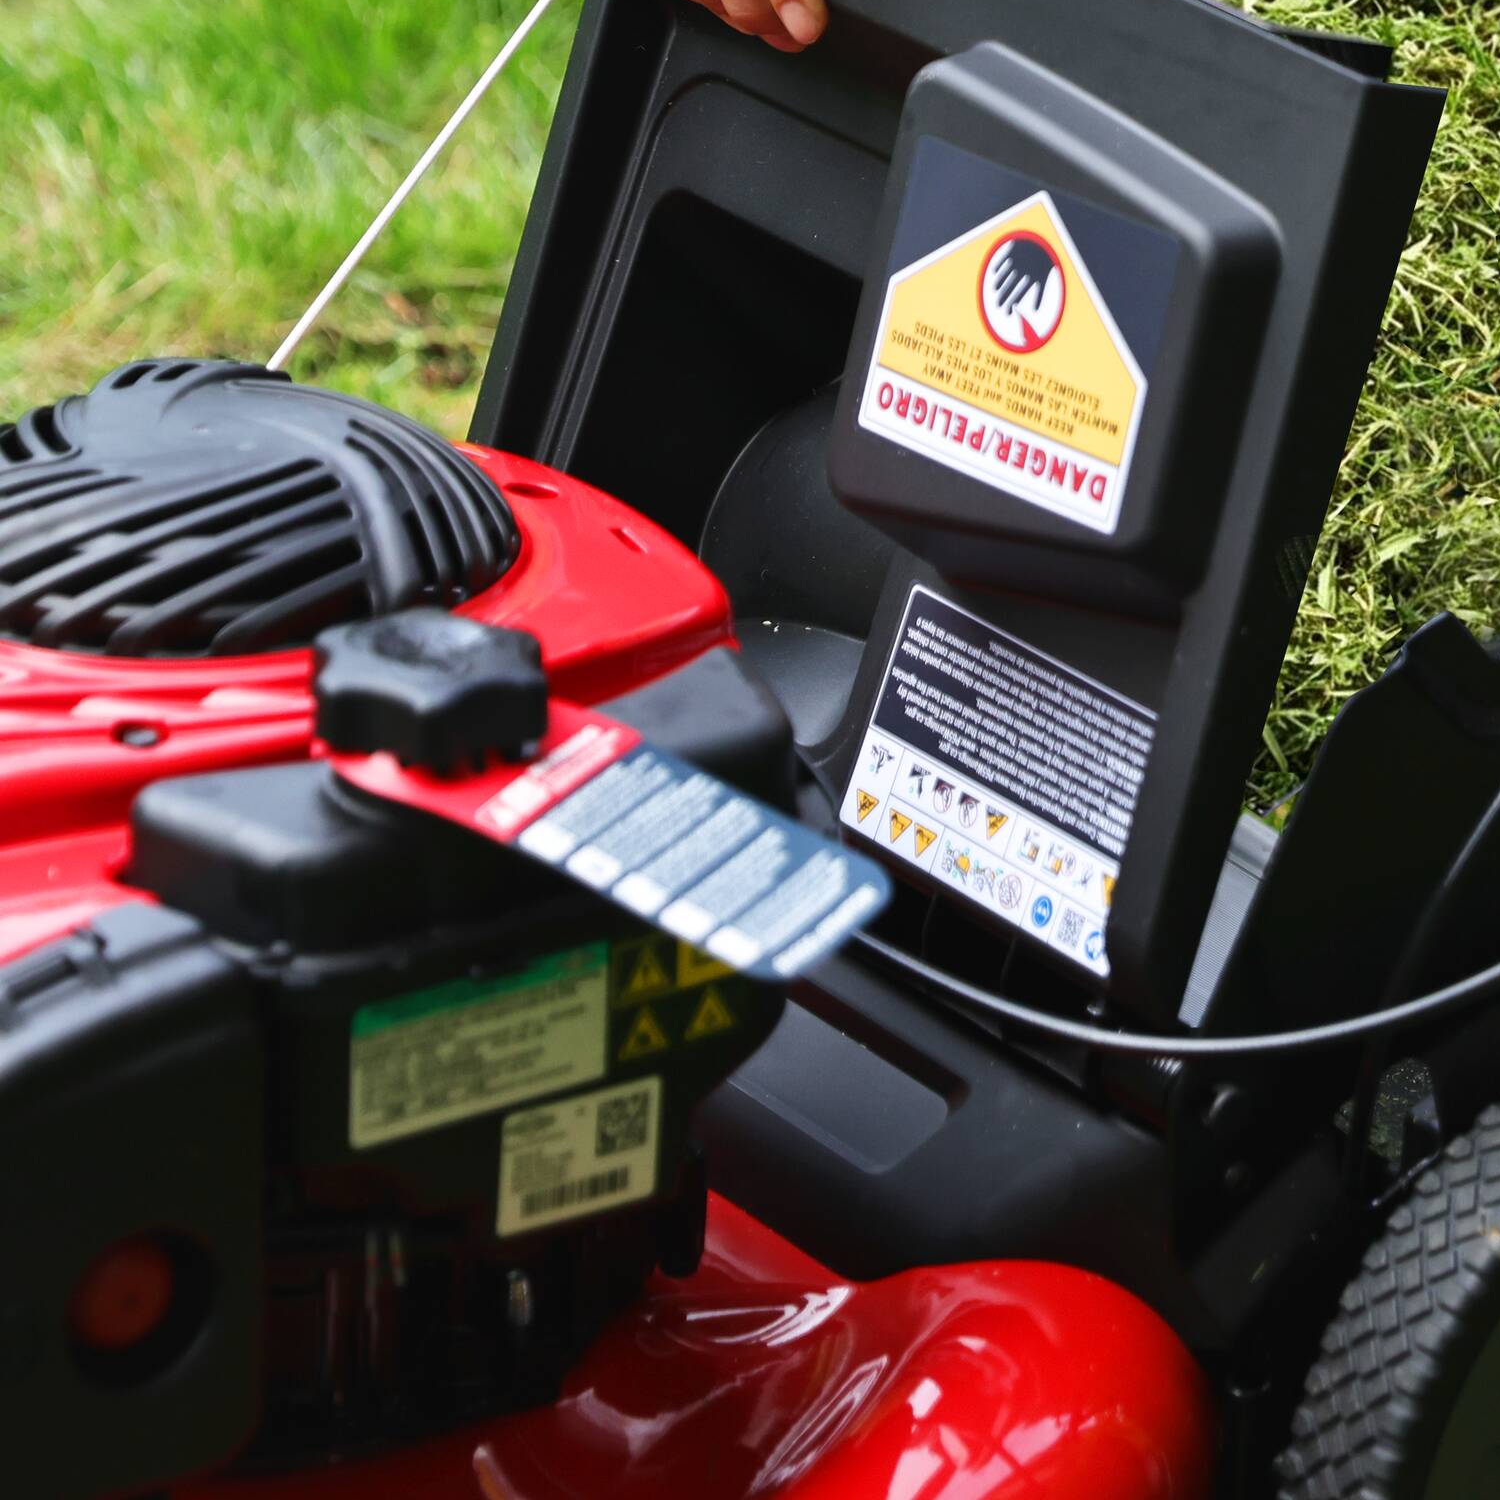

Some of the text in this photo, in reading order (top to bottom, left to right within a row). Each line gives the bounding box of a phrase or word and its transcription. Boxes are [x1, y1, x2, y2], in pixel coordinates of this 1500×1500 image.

[914, 322, 944, 343] PIEDS
[891, 330, 942, 360] ALEJADOS
[948, 336, 966, 353] LES
[970, 347, 981, 358] ET
[946, 354, 969, 372] PIES
[985, 353, 1019, 375] MAINS
[973, 365, 992, 382] LOS
[996, 376, 1002, 386] Y
[1023, 369, 1042, 386] LES
[923, 363, 1074, 434] KEEP HANDS and FEET AWAY
[1006, 380, 1043, 404] MANOS
[1047, 397, 1067, 414] LAS
[877, 381, 1107, 502] DANGER/PELIGRO
[919, 649, 941, 670] pueden
[892, 665, 917, 687] agencies
[897, 683, 908, 698] dry
[926, 687, 941, 701] local
[907, 691, 927, 709] around
[940, 695, 962, 714] contact
[940, 710, 954, 725] start
[954, 718, 965, 729] can
[962, 707, 982, 724] should
[965, 724, 978, 738] that
